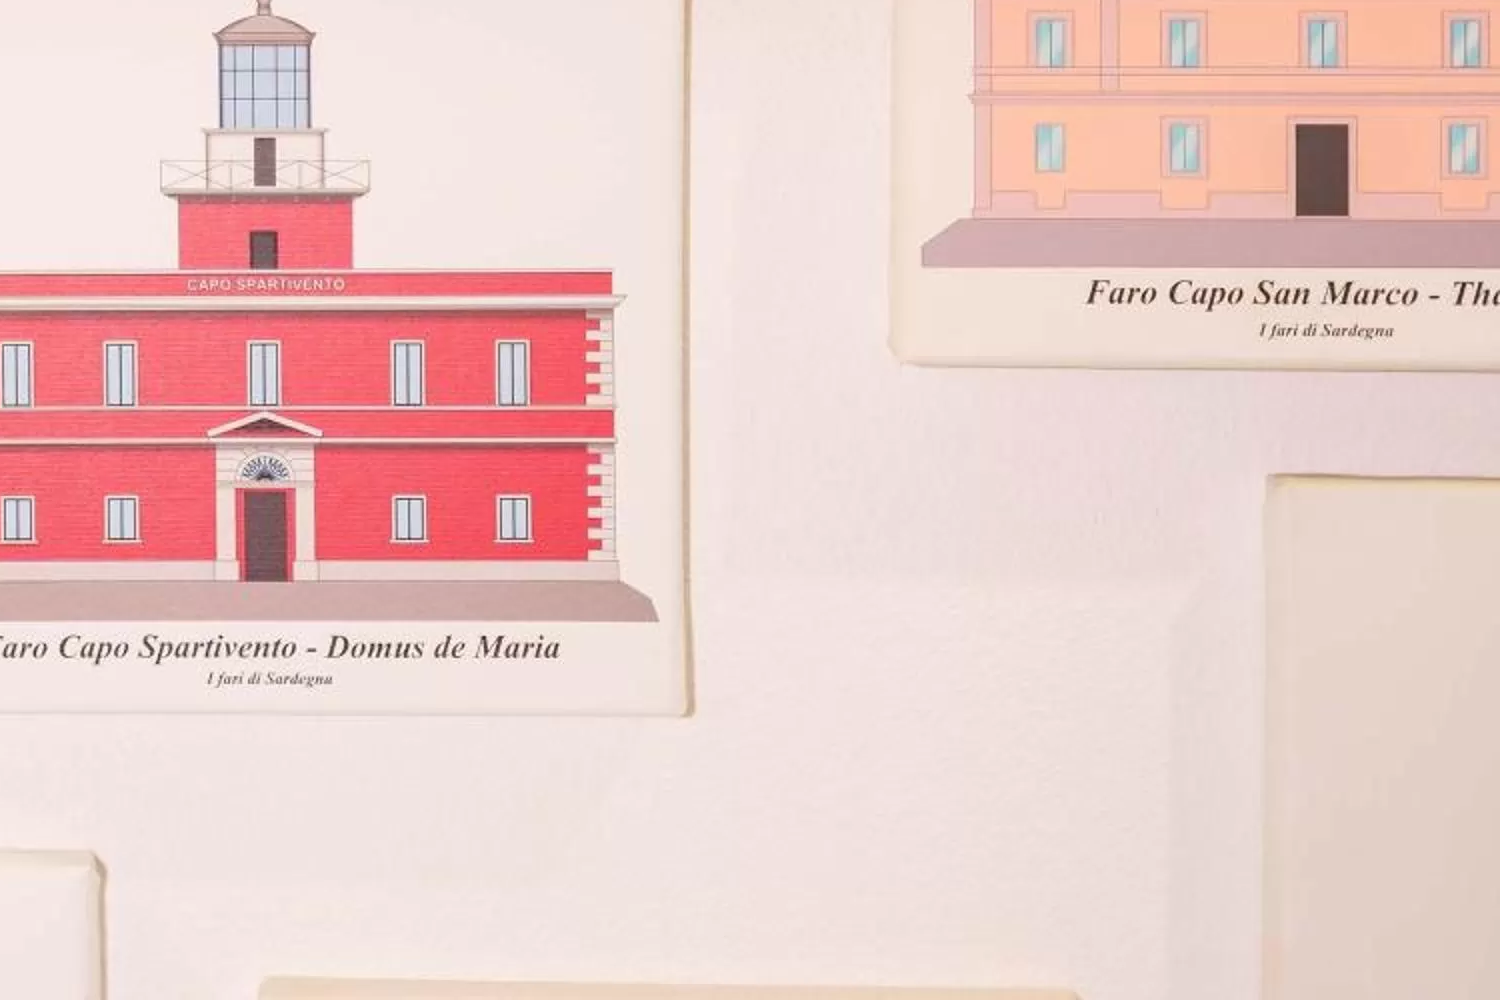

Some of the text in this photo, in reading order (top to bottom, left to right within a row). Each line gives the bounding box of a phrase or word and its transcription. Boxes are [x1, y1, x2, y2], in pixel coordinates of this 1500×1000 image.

[187, 277, 346, 292] CAPO SPARTIVENTO
[1086, 279, 1158, 306] Faro
[1168, 279, 1245, 313] Capo
[1252, 279, 1311, 306] San
[1320, 280, 1419, 307] Marco
[1258, 322, 1396, 341] I fari di Sardegna
[58, 634, 130, 666] Capo
[137, 633, 298, 666] Spartivento
[324, 635, 425, 659] Domus
[433, 634, 466, 659] de
[473, 634, 561, 660] Maria
[215, 671, 244, 689] fari
[247, 671, 262, 685] di
[265, 671, 334, 688] Sardegna
